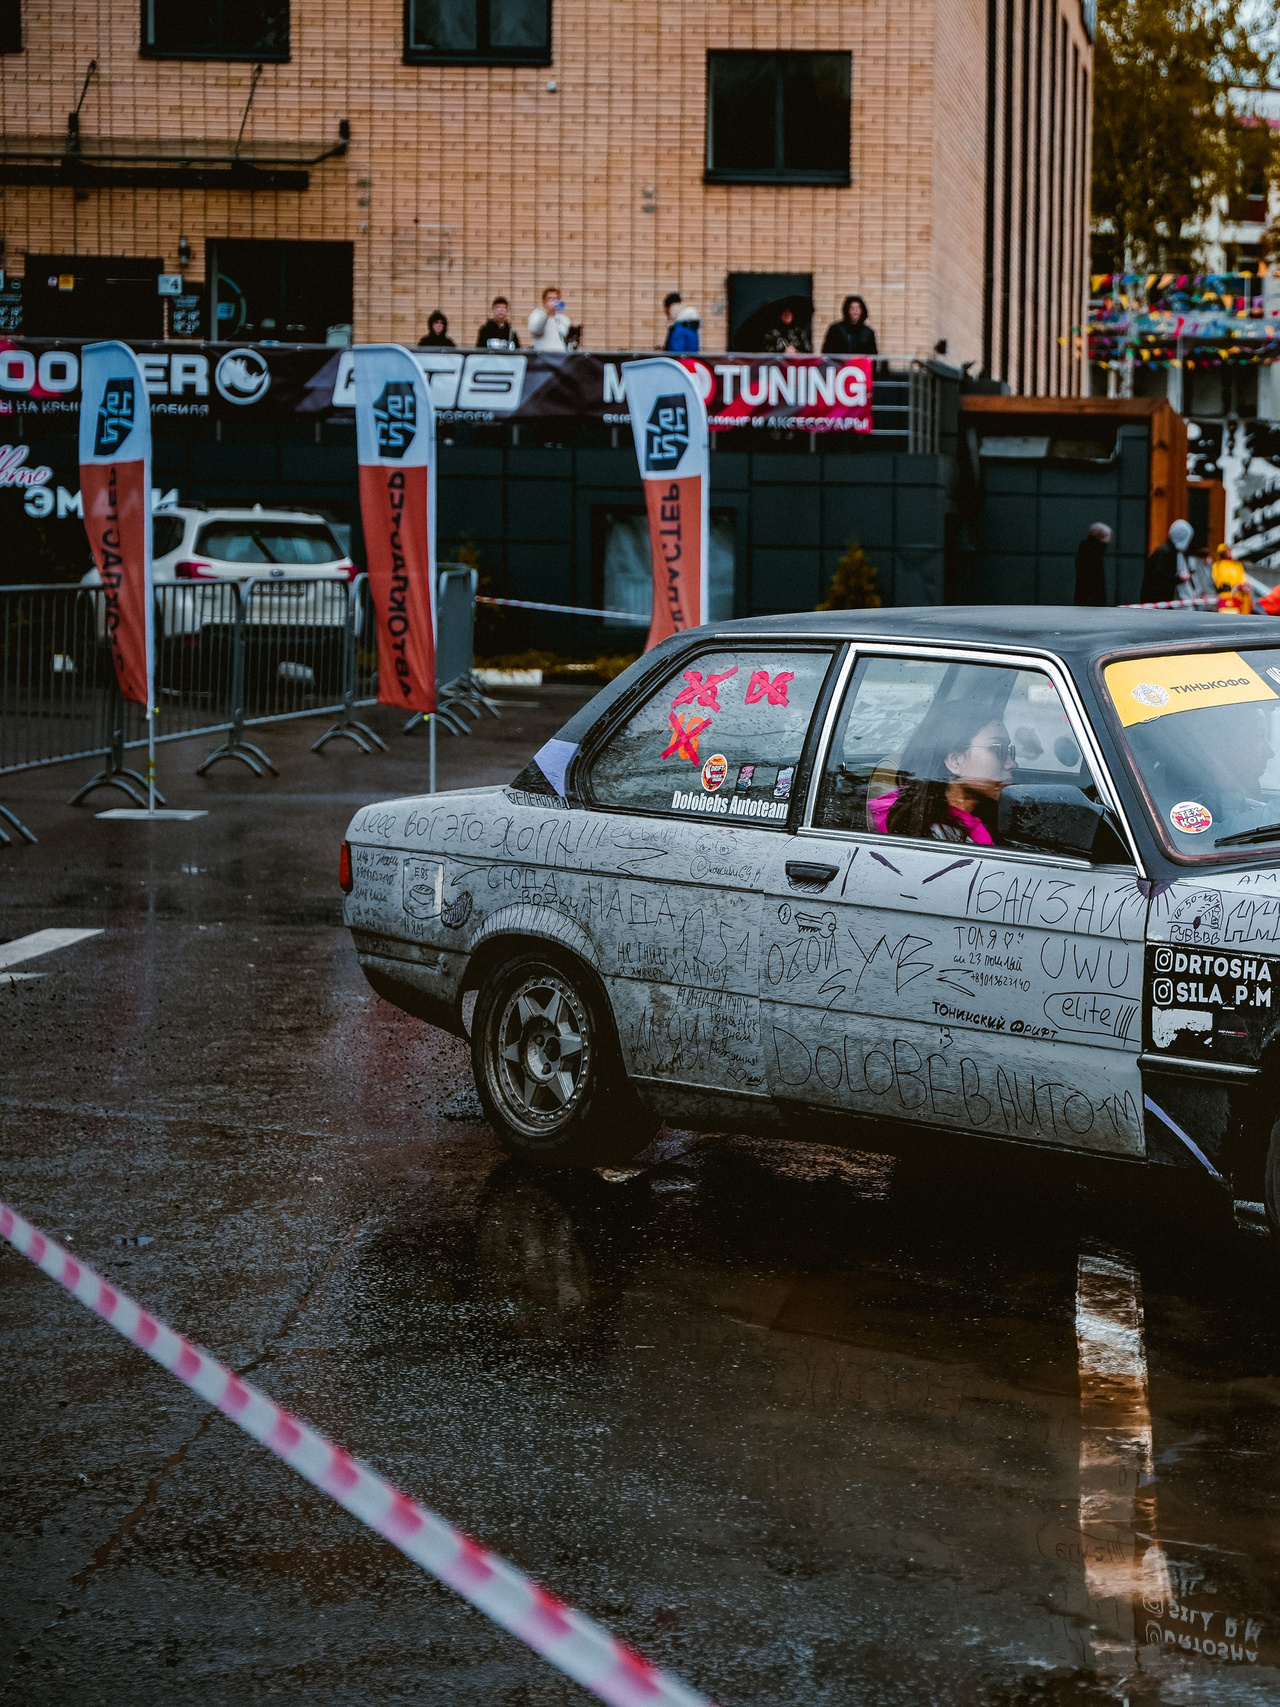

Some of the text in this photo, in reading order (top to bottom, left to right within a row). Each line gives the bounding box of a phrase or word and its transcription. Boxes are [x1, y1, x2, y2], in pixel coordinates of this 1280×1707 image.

[1170, 677, 1250, 695] ТИНЬКОФФ
[672, 790, 789, 820] Dolobebs Autoteam
[1174, 953, 1272, 983] DRTOSHA
